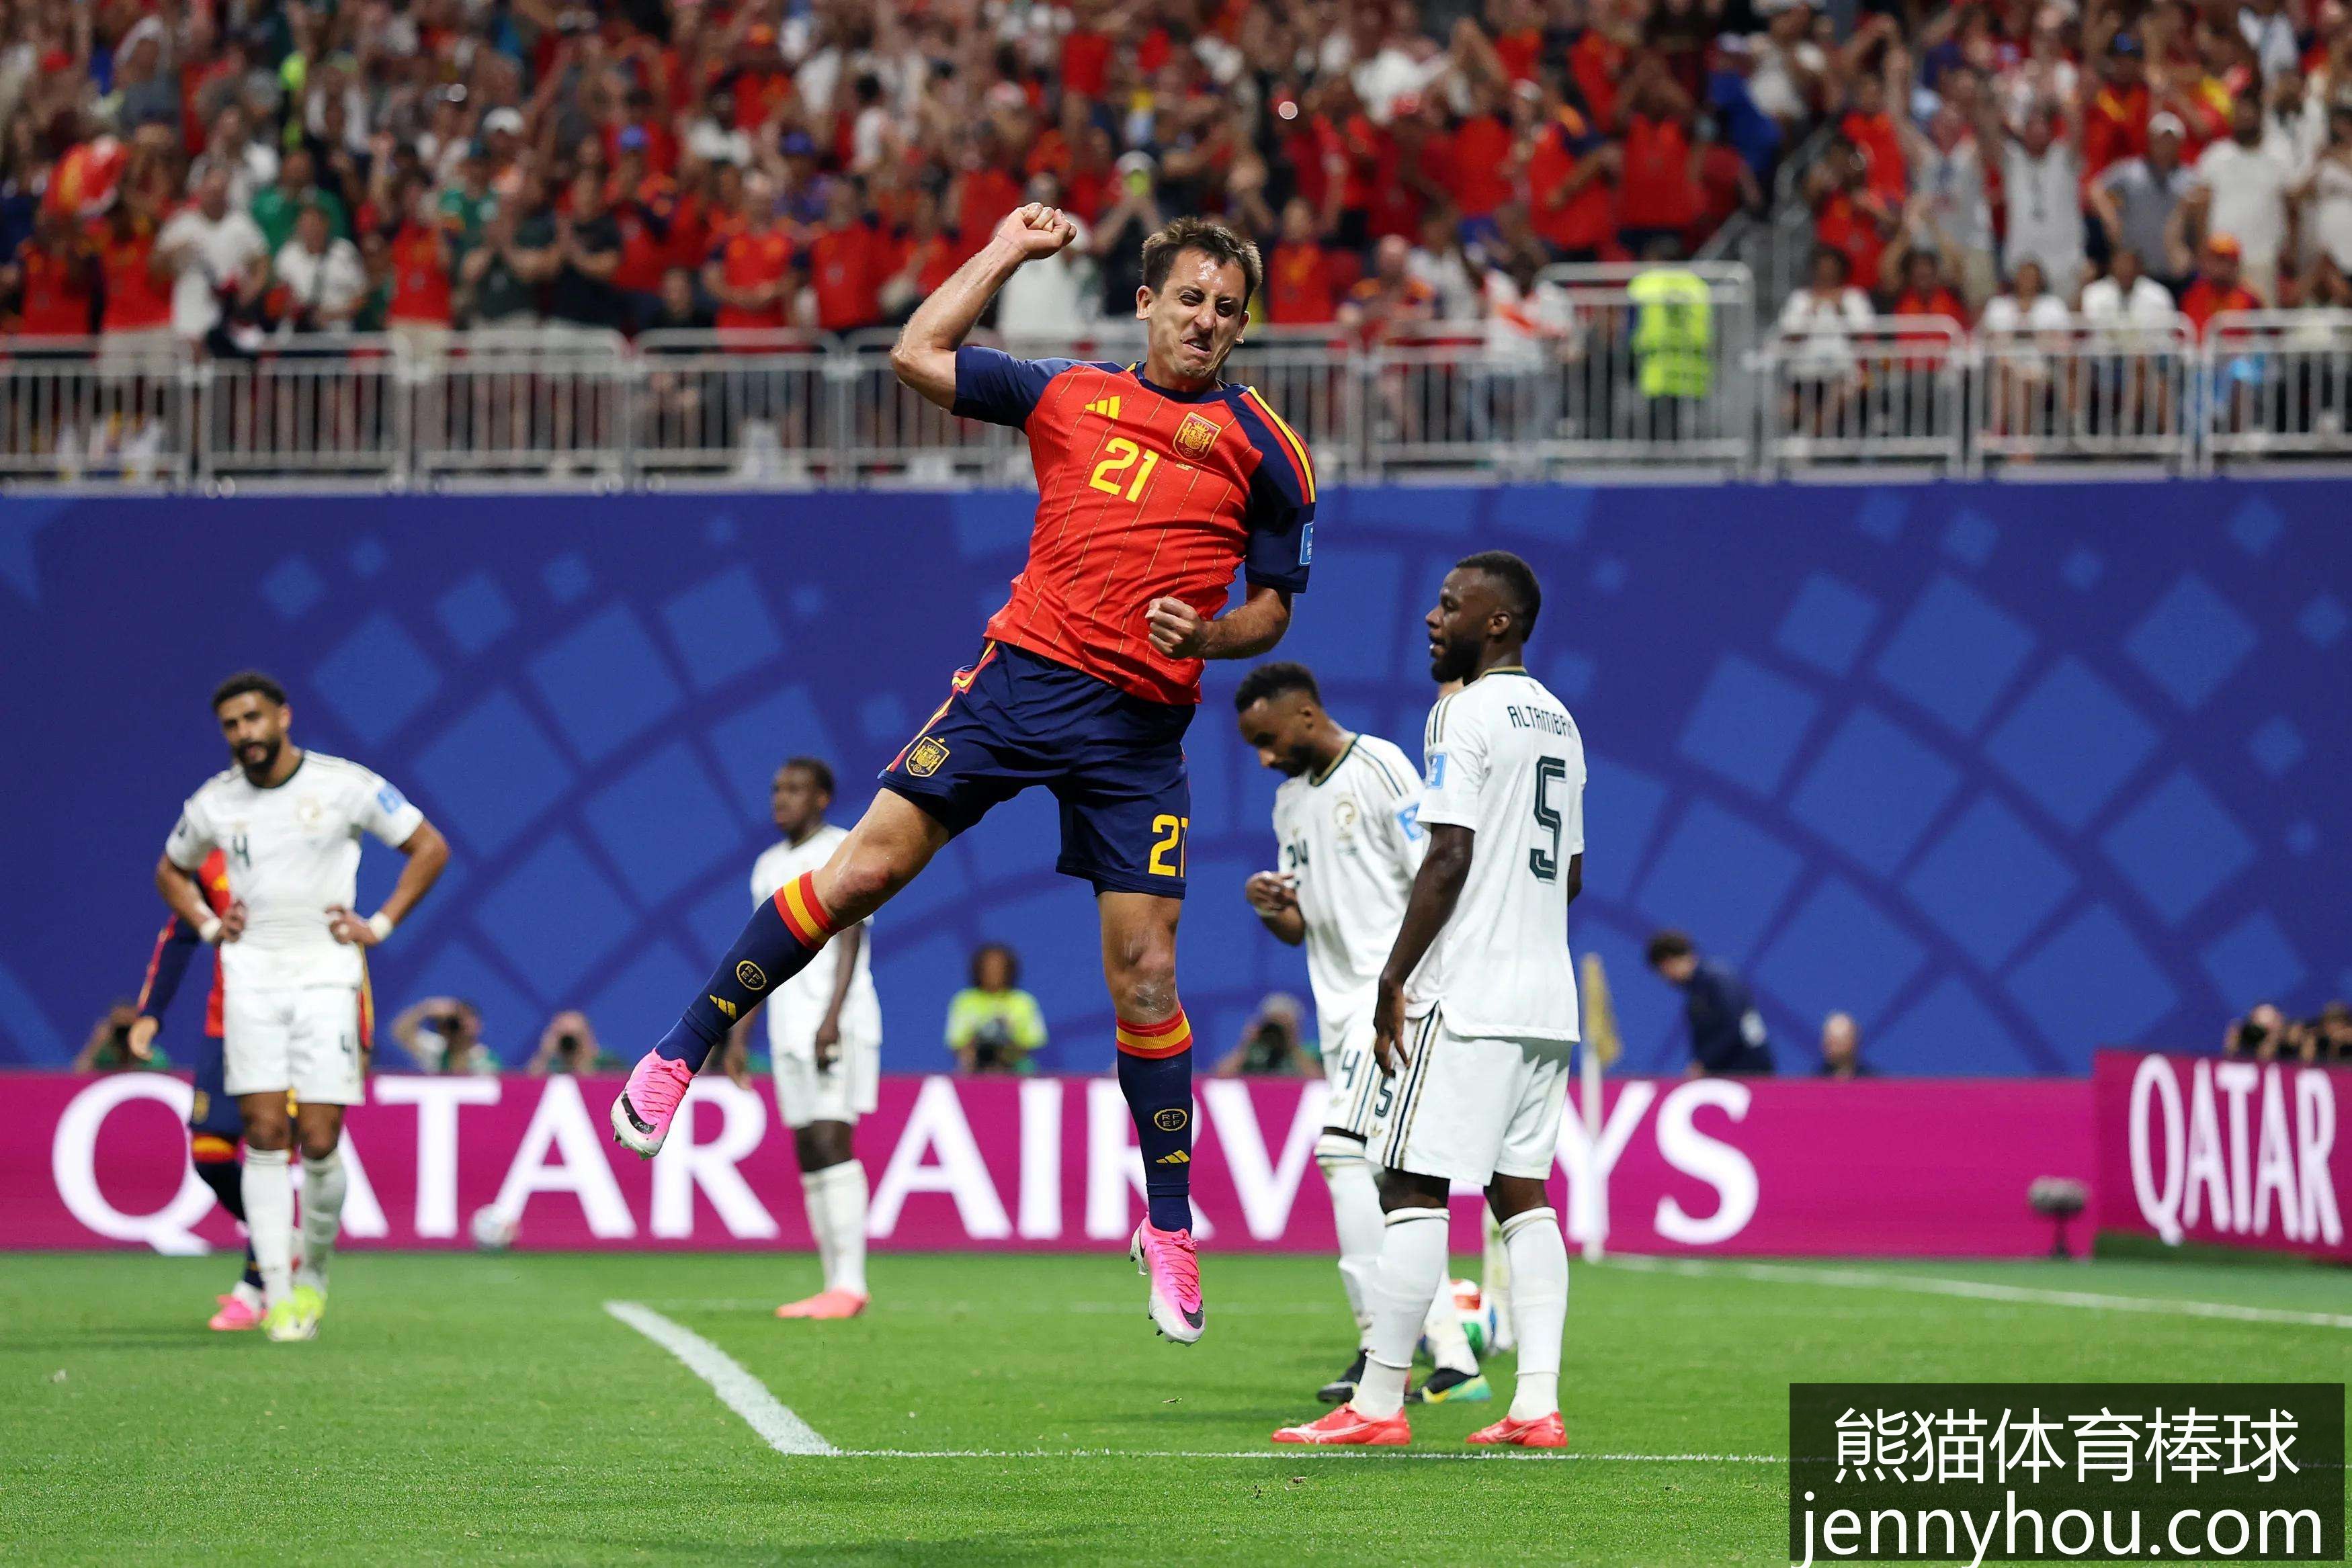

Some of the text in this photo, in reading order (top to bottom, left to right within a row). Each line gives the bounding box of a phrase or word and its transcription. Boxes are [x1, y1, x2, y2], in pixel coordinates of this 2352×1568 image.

[1089, 437, 1159, 503] 21
[1507, 705, 1579, 742] ALTAMBA
[232, 834, 251, 869] 4
[1529, 756, 1566, 882] 5
[1375, 1070, 1397, 1117] 5
[866, 1076, 1759, 1244] AIRYS
[2129, 1053, 2344, 1246] QATAR
